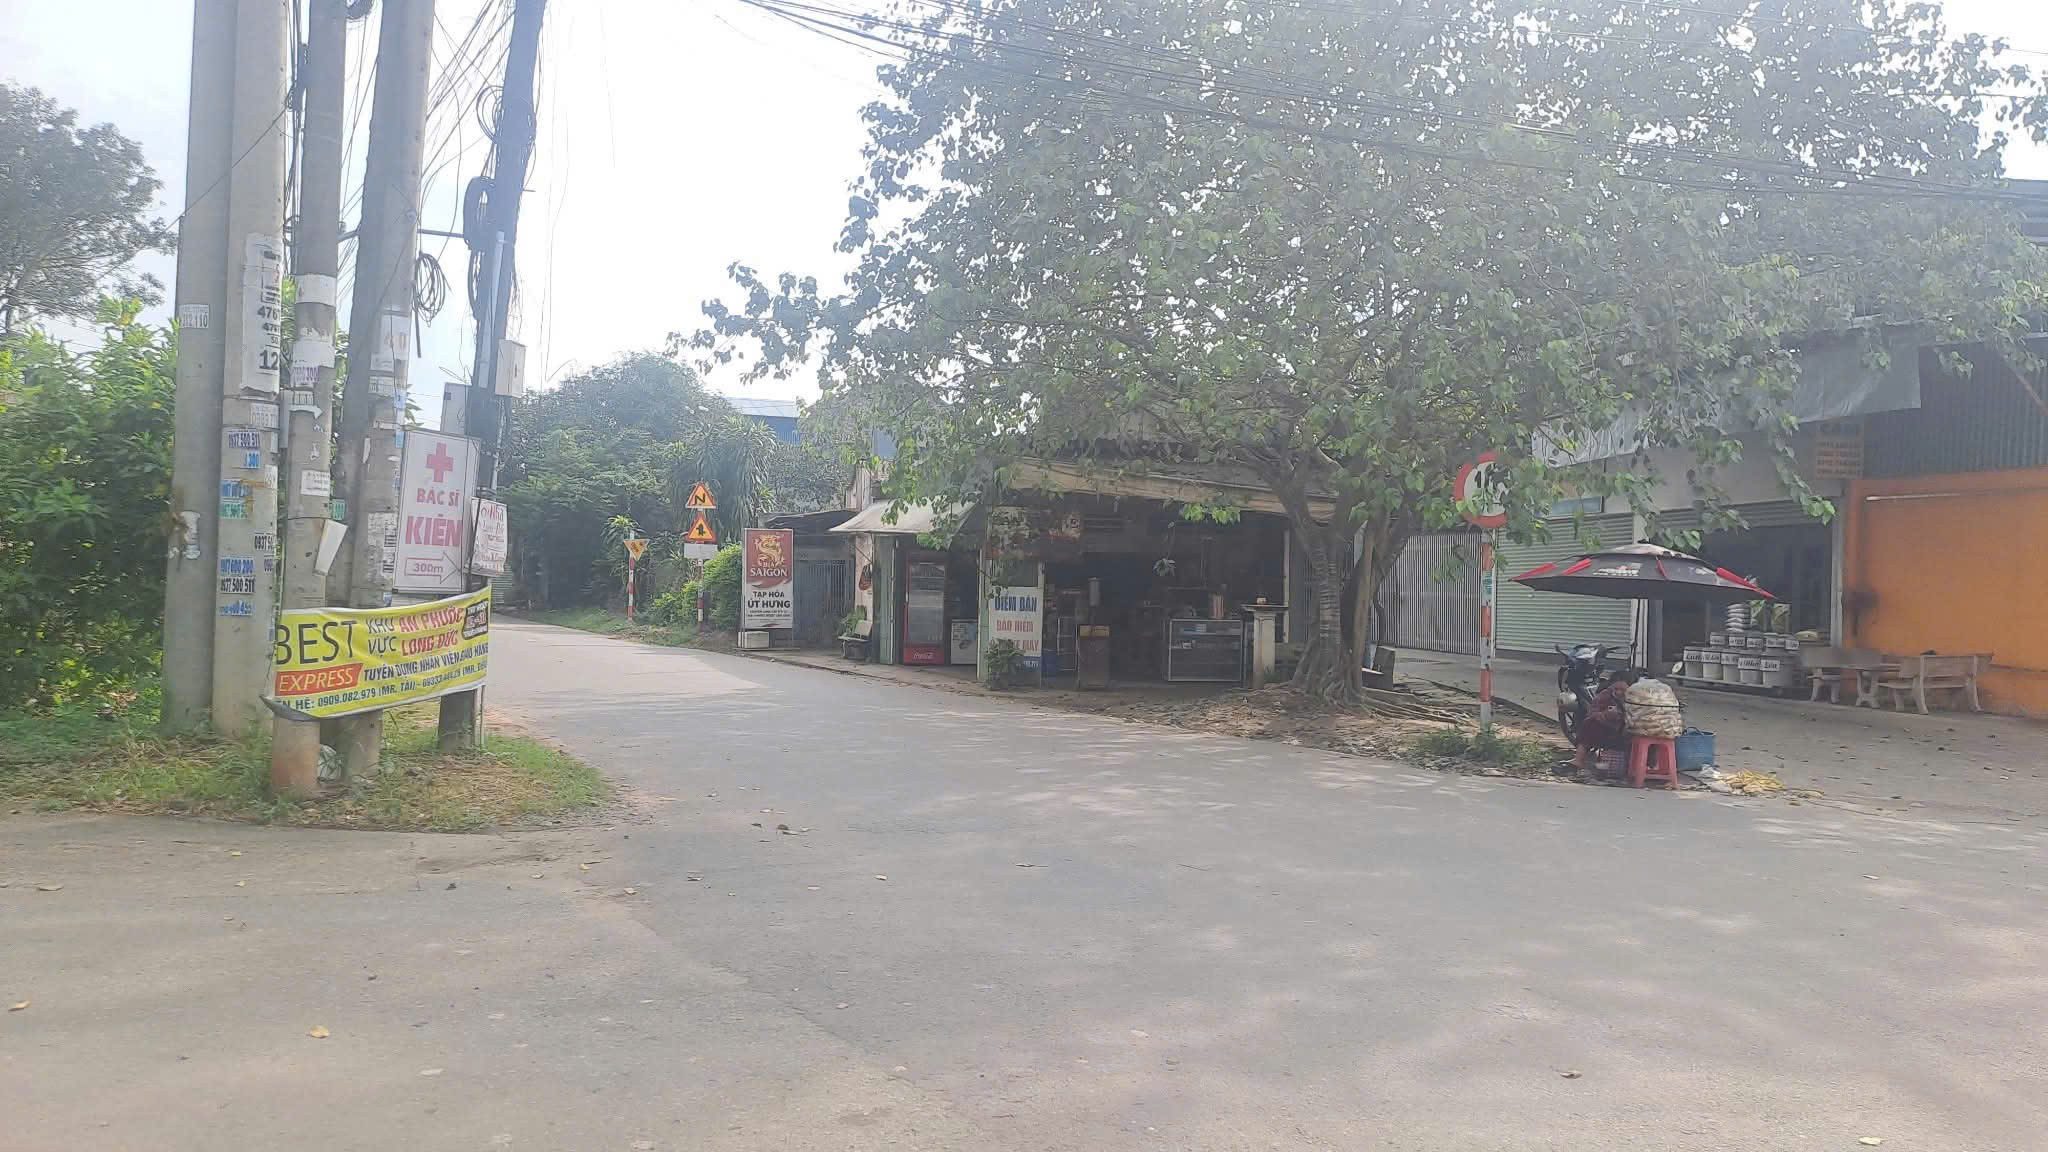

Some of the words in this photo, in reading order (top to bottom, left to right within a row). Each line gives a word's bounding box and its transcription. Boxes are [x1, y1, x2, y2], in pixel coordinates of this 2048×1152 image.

[414, 563, 444, 574] 300m
[750, 567, 788, 577] SAIGON
[762, 600, 791, 609] HƯNG
[366, 616, 395, 634] KHU
[400, 614, 420, 633] AN
[275, 620, 357, 665] BEST
[368, 636, 397, 658] VỰC
[401, 635, 434, 656] LONG
[279, 667, 353, 692] EXPRESS
